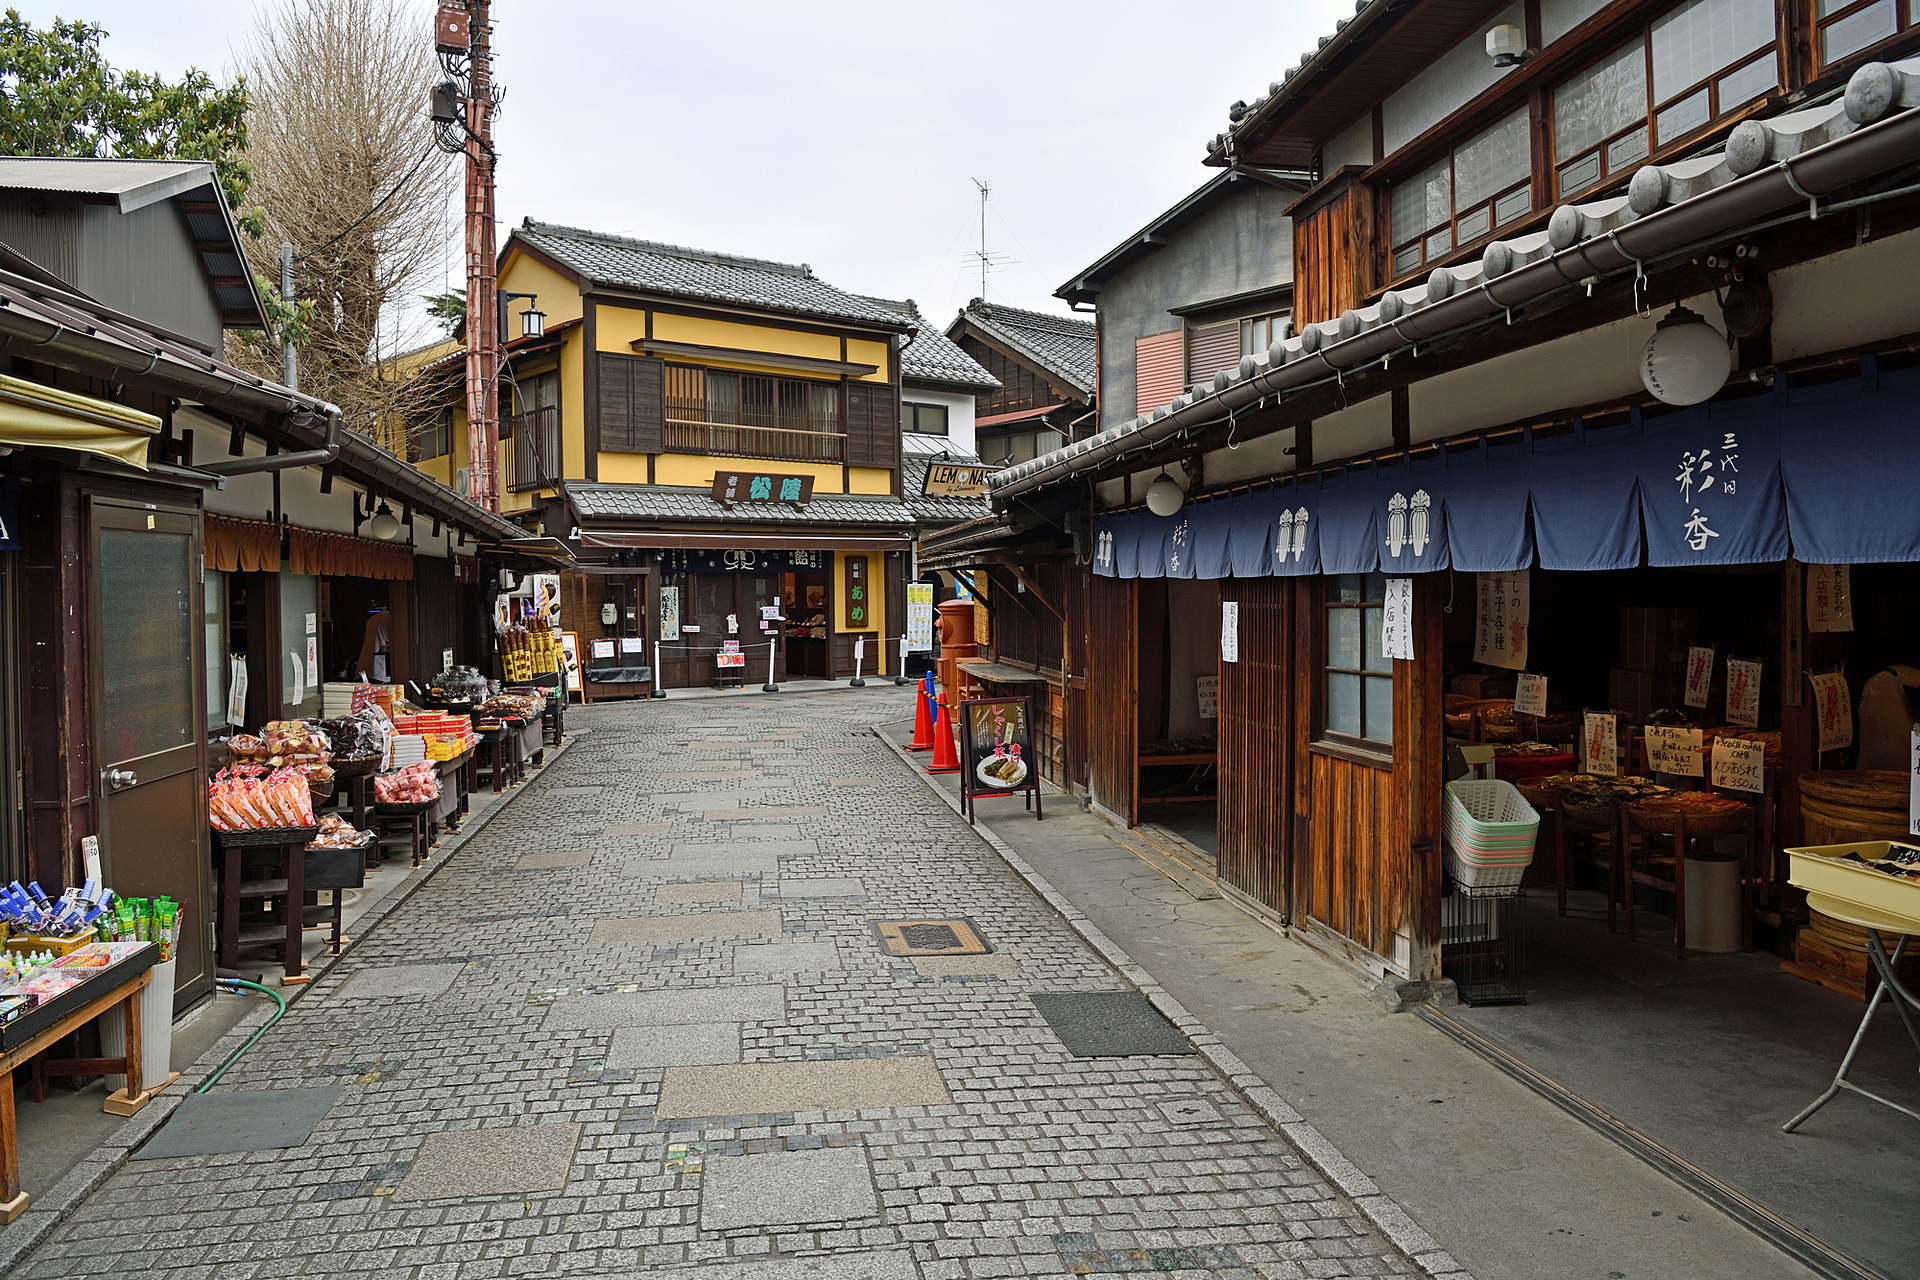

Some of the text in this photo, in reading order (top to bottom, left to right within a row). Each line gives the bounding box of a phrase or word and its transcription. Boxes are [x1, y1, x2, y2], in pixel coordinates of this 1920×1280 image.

[1719, 433, 1739, 495] 三代目
[725, 475, 738, 498] 老舗
[750, 476, 802, 501] 松陸
[1675, 449, 1719, 551] 彩香
[1170, 525, 1182, 572] 彩香
[851, 585, 864, 621] あめ
[1816, 566, 1829, 622] 入店禁止
[1386, 588, 1397, 655] 入店禁止
[1750, 669, 1759, 711] いもチップス
[992, 705, 1006, 758] しゃくし菜
[1607, 720, 1615, 762] 野菜チップス
[1009, 743, 1022, 765] 漬け
[1714, 759, 1759, 779] えびあられ
